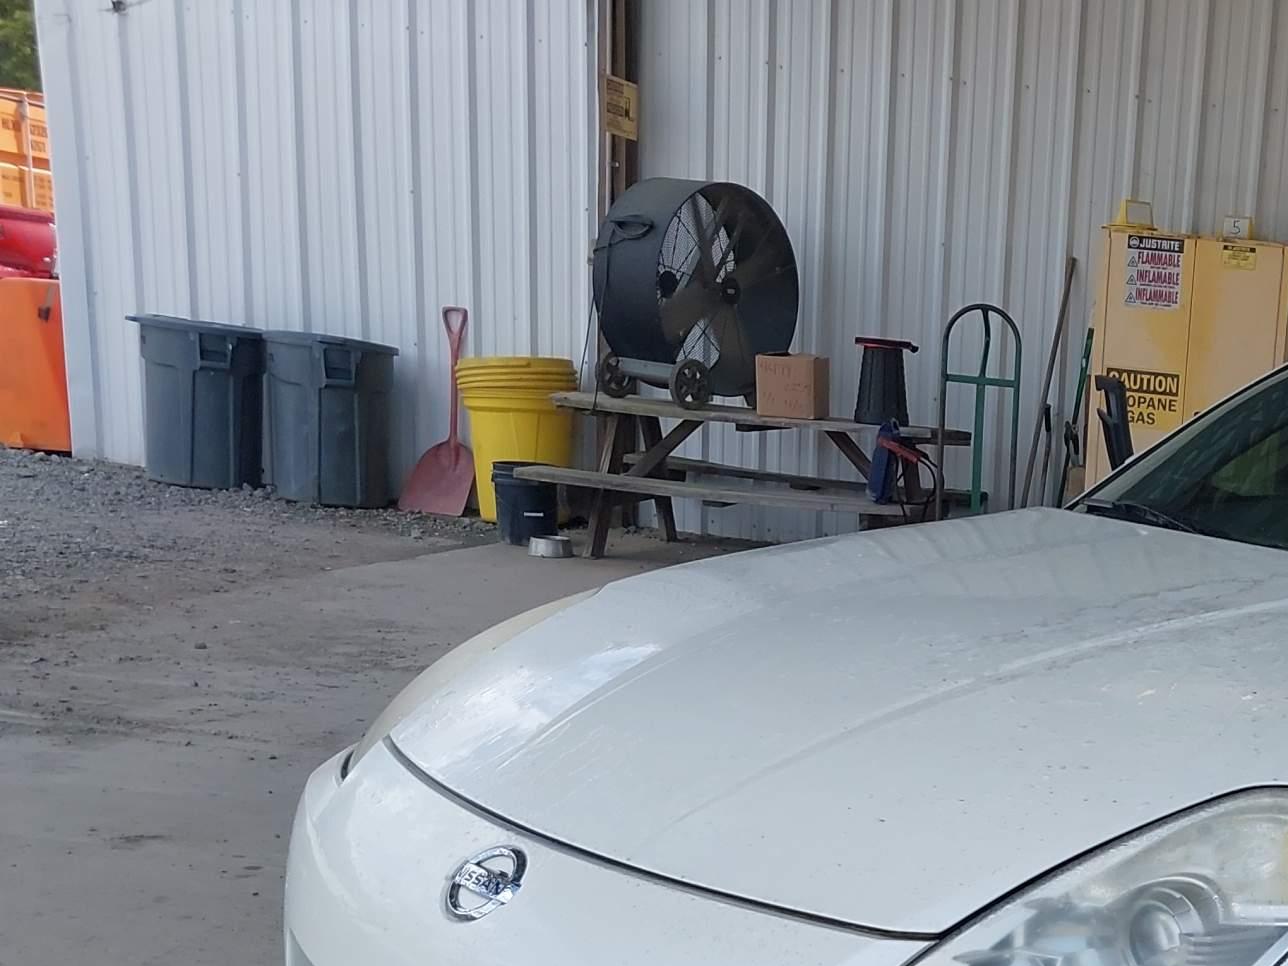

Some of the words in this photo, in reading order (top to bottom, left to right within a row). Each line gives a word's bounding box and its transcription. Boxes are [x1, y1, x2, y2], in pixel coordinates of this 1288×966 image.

[1231, 220, 1241, 235] 5
[1140, 238, 1180, 251] JUSTRITE
[1137, 251, 1181, 268] FLAMMABLE
[1136, 269, 1180, 286] INFLAMABLE
[1135, 287, 1179, 305] INFLAMMABLE
